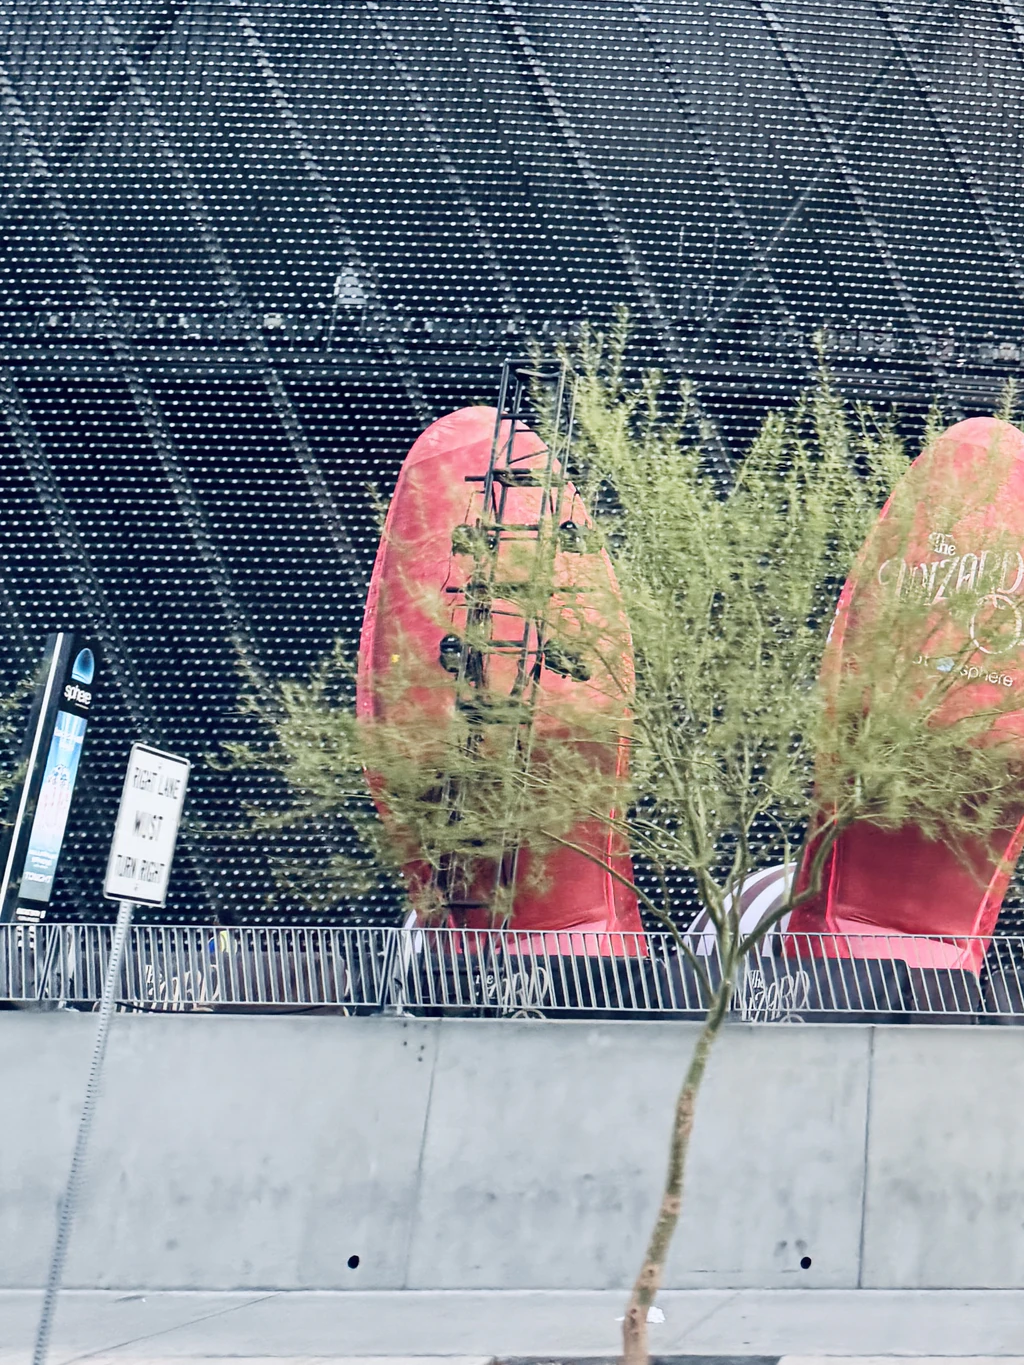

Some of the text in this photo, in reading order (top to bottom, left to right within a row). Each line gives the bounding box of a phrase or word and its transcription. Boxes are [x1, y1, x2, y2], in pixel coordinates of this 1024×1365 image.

[132, 766, 181, 800] RIGHT LANE
[115, 854, 166, 884] TURN RIGHT
